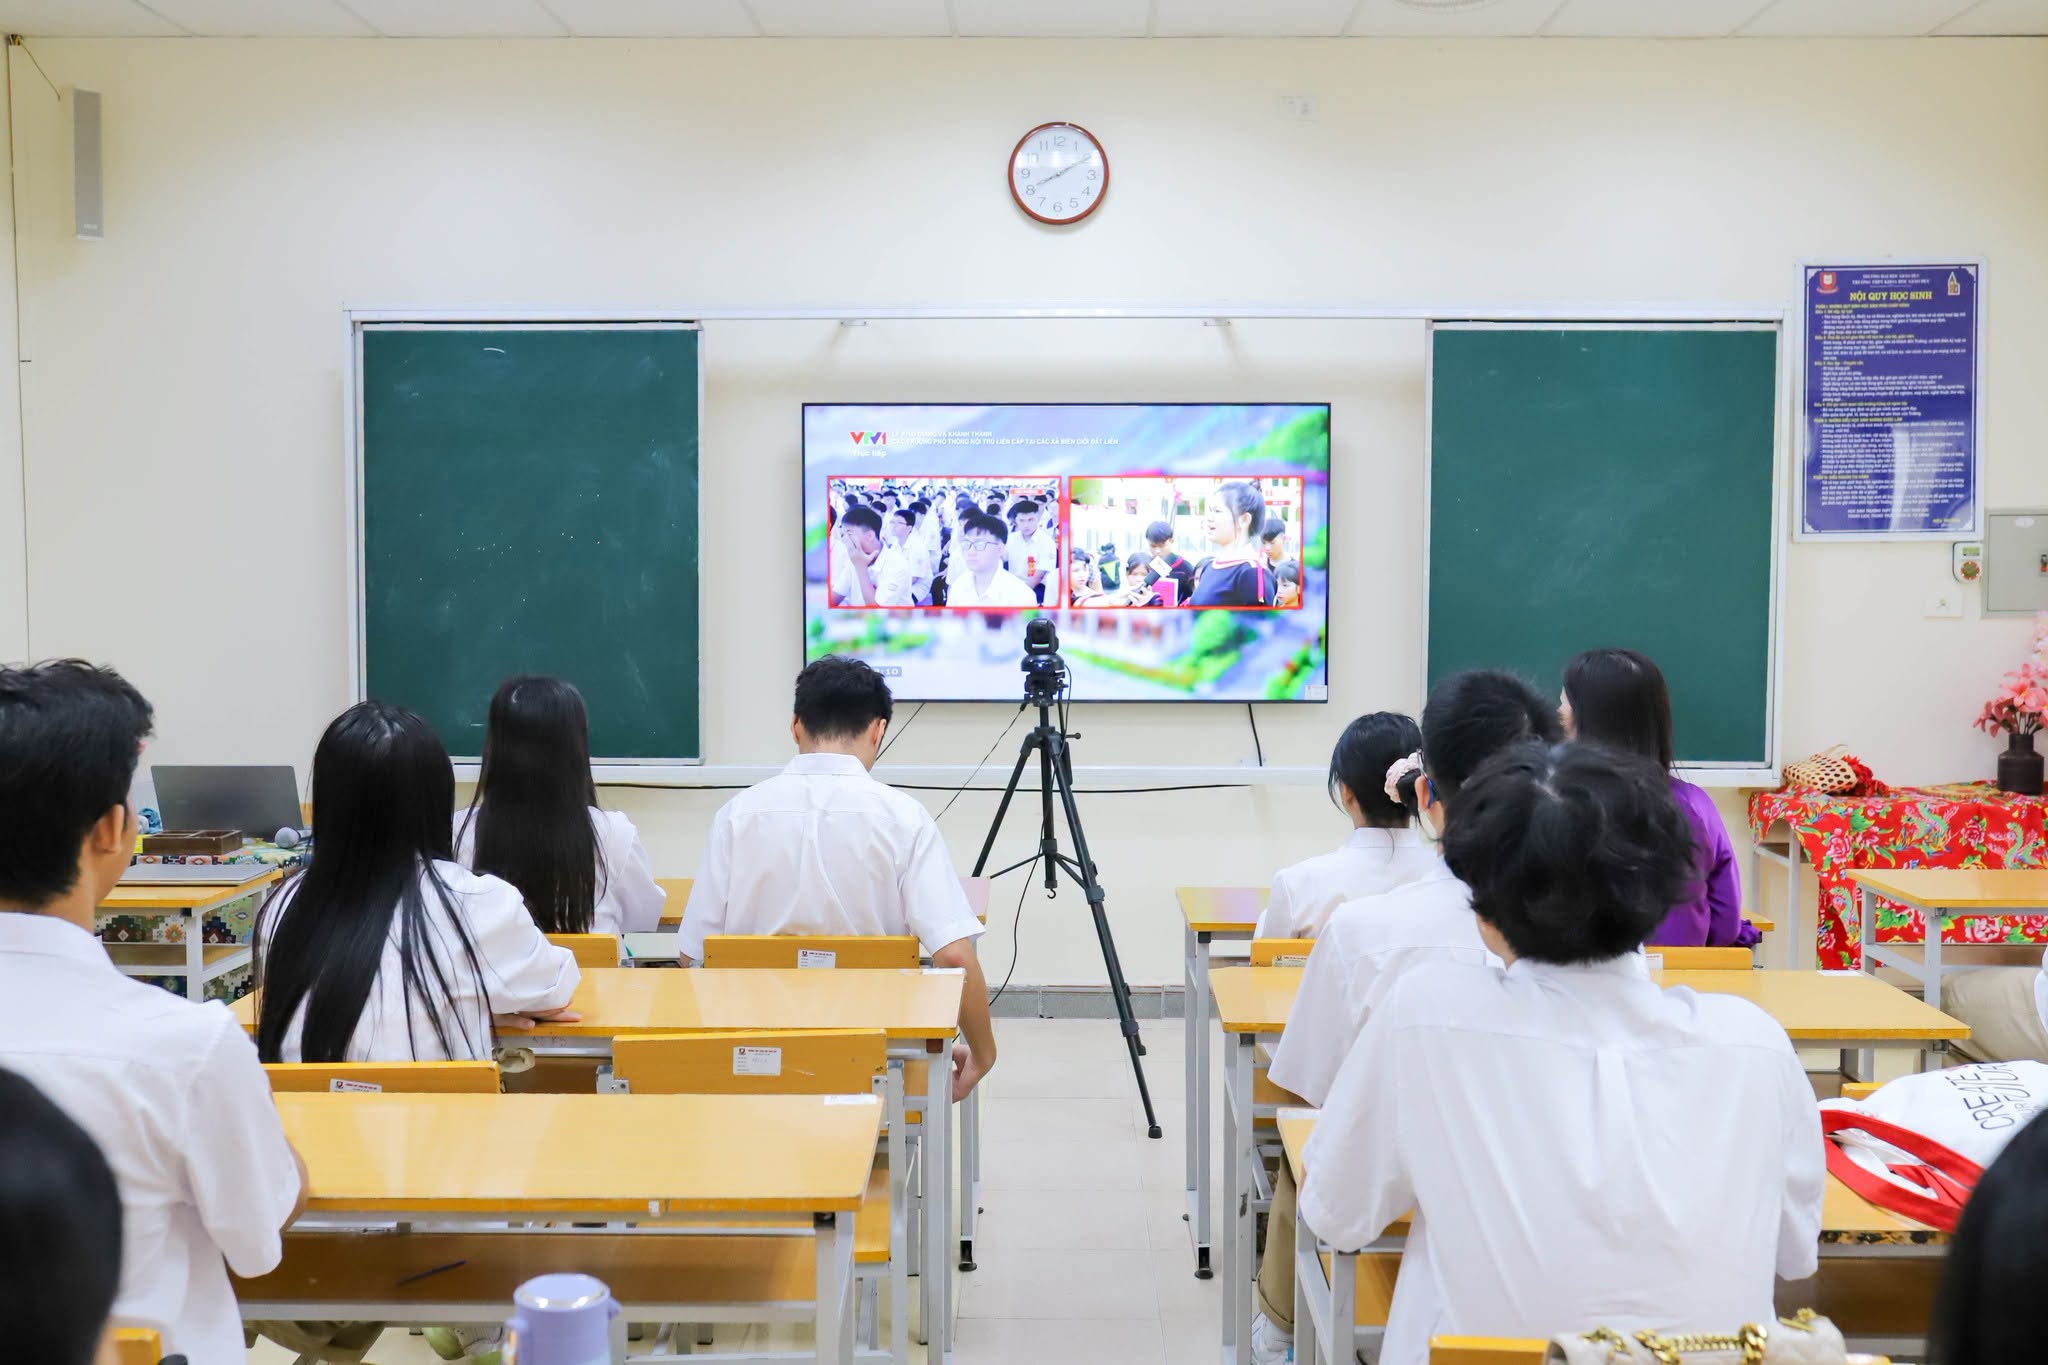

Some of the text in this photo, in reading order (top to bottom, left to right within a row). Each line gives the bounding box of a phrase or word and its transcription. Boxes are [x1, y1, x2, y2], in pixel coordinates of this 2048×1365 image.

[1039, 140, 1048, 151] 11
[1053, 136, 1066, 147] 12
[1021, 168, 1031, 178] 9
[1087, 169, 1096, 180] 3
[1026, 184, 1036, 195] 8
[1081, 186, 1091, 196] 4
[1037, 196, 1047, 207] 7
[1053, 201, 1063, 212] 6
[1069, 197, 1079, 208] 5
[1850, 290, 1932, 302] NỘI QUY HỌC SINH
[850, 431, 887, 445] VTV1
[1945, 1073, 2015, 1129] CREATE
